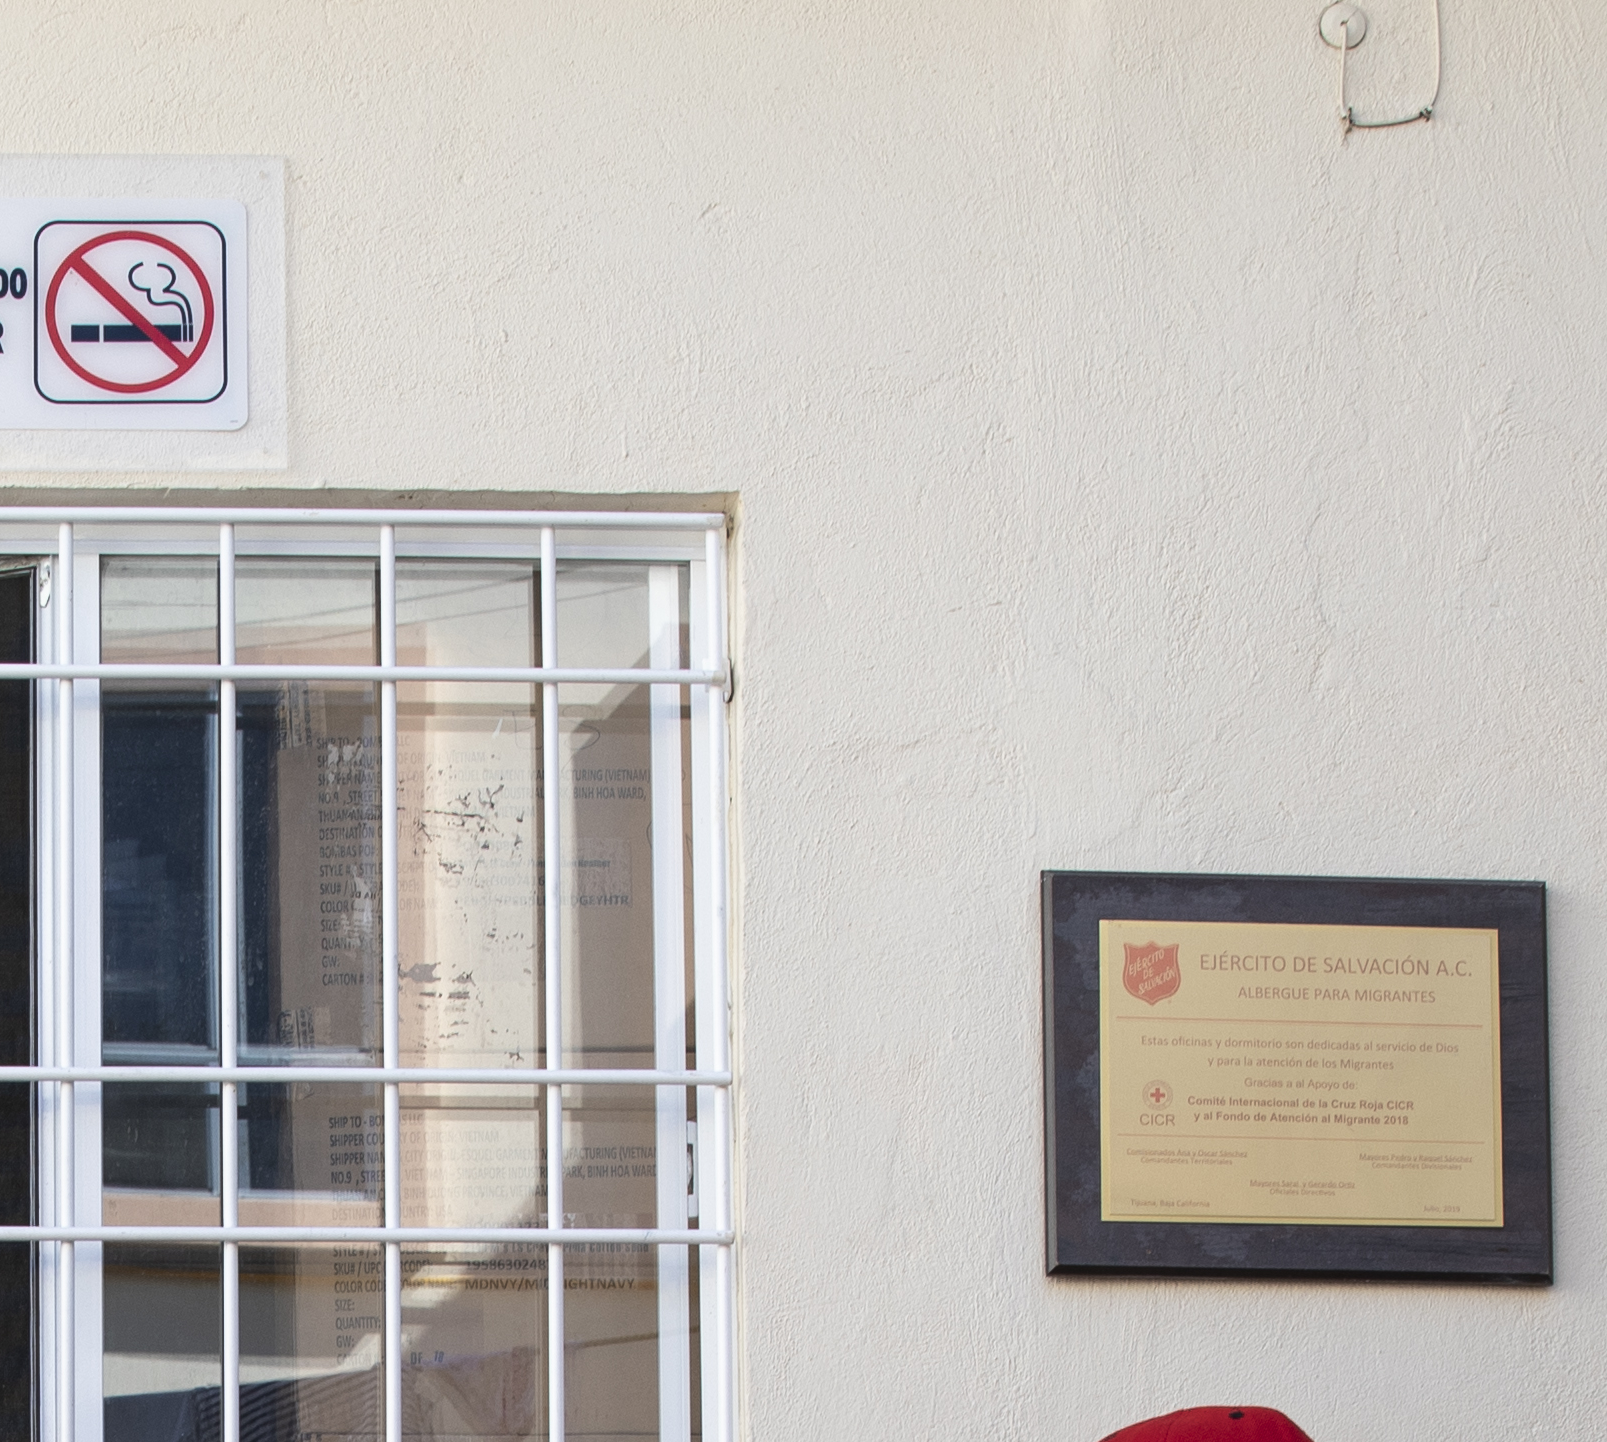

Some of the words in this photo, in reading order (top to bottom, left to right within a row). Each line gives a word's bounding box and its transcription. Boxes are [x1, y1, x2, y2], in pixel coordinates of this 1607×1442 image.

[574, 787, 596, 799] BINH
[596, 787, 615, 799] HOA
[1129, 949, 1165, 977] EJÉRCITO
[1200, 949, 1287, 972] EJÉRCITO
[1293, 956, 1317, 973] DE
[1323, 954, 1430, 976] SALVACIÓN
[1436, 959, 1472, 977] A.C.
[1143, 967, 1155, 980] DE
[1238, 986, 1310, 1001] ALBERGUE
[1314, 988, 1350, 1001] PARA
[1354, 989, 1436, 1003] MIGRANTES
[1141, 1035, 1169, 1046] Estas
[1171, 1035, 1213, 1047] oficinas
[1215, 1039, 1222, 1049] y
[1224, 1037, 1282, 1049] dormitorio
[1285, 1041, 1304, 1050] son
[1307, 1039, 1361, 1051] dedicadas
[1364, 1041, 1373, 1051] al
[1375, 1041, 1417, 1053] servicio
[1419, 1041, 1433, 1053] de
[1435, 1042, 1459, 1054] Dios
[1207, 1057, 1214, 1067] y
[1216, 1057, 1241, 1067] para
[1244, 1056, 1253, 1066] la
[1256, 1056, 1303, 1068] atención
[1305, 1058, 1319, 1068] de
[1321, 1058, 1337, 1069] los
[1340, 1058, 1394, 1072] Migrantes
[1244, 1077, 1283, 1089] Gracias
[1286, 1080, 1293, 1089] a
[1295, 1078, 1305, 1089] al
[1307, 1078, 1340, 1091] Apoyo
[1342, 1080, 1358, 1091] de:
[1187, 1095, 1226, 1106] Comité
[1229, 1096, 1299, 1108] Internacional
[1302, 1098, 1316, 1109] de
[1318, 1098, 1328, 1109] la
[1331, 1099, 1357, 1110] Cruz
[1359, 1099, 1384, 1112] Roja
[1386, 1100, 1415, 1111] CICR
[329, 1116, 348, 1129] SHIP
[349, 1116, 362, 1128] TO
[1139, 1113, 1176, 1127] CICR
[1193, 1112, 1200, 1123] y
[1203, 1111, 1213, 1121] al
[1216, 1111, 1251, 1122] Fondo
[1253, 1112, 1266, 1122] de
[1269, 1112, 1318, 1123] Atención
[1321, 1113, 1331, 1124] al
[1334, 1114, 1381, 1126] Migrante
[1384, 1115, 1409, 1126] 2018
[329, 1133, 364, 1147] SHIPPER
[330, 1152, 364, 1166] SHIPPER
[587, 1165, 609, 1178] BINH
[610, 1165, 629, 1177] HOA
[335, 1299, 355, 1311] SIZE:
